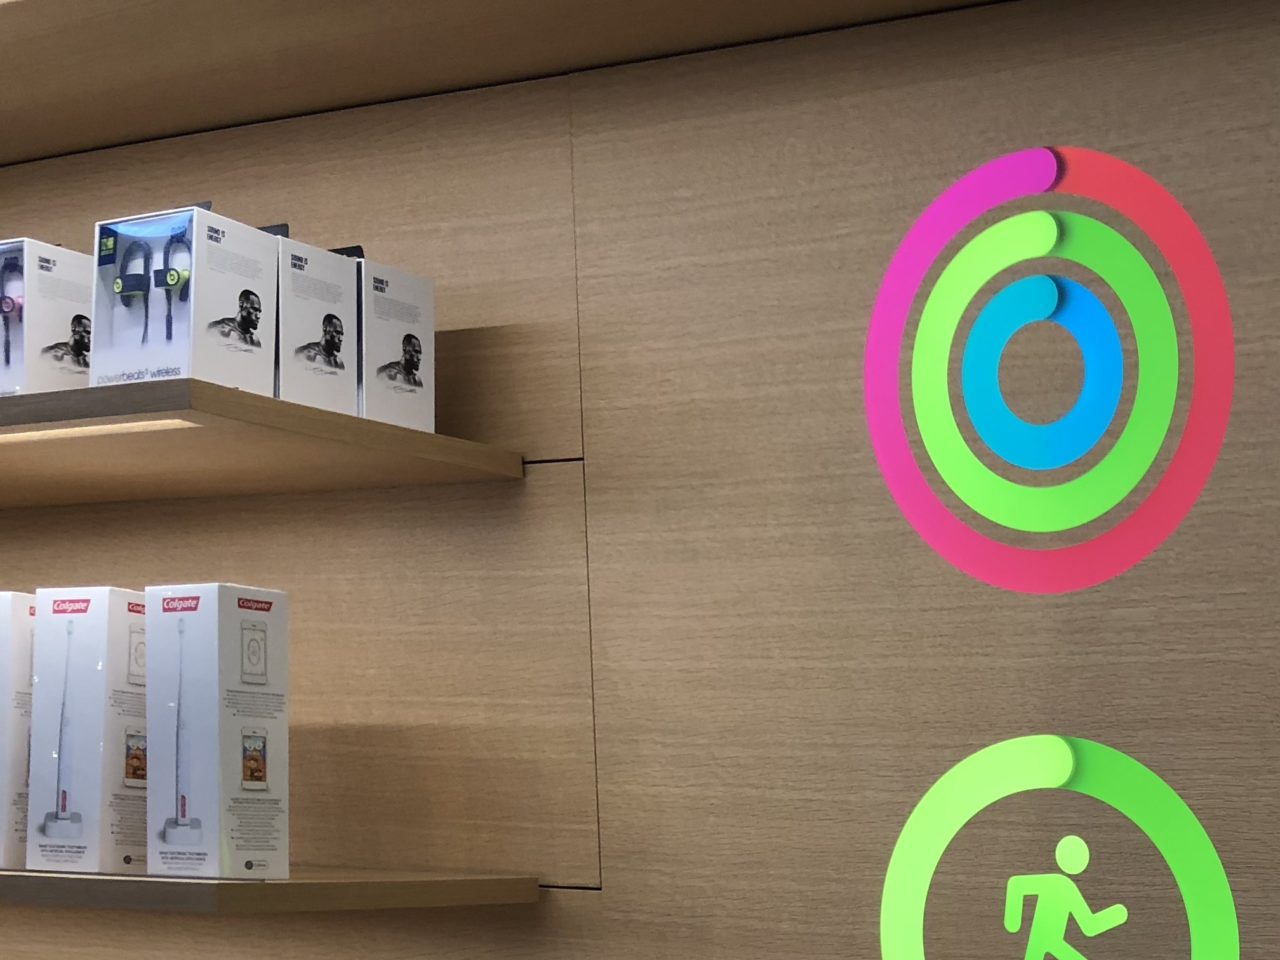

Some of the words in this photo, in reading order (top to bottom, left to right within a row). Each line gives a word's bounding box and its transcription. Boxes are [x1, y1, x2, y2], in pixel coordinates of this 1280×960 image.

[54, 600, 88, 612] Colgate
[164, 599, 197, 610] Colgate
[240, 600, 270, 610] Colgate
